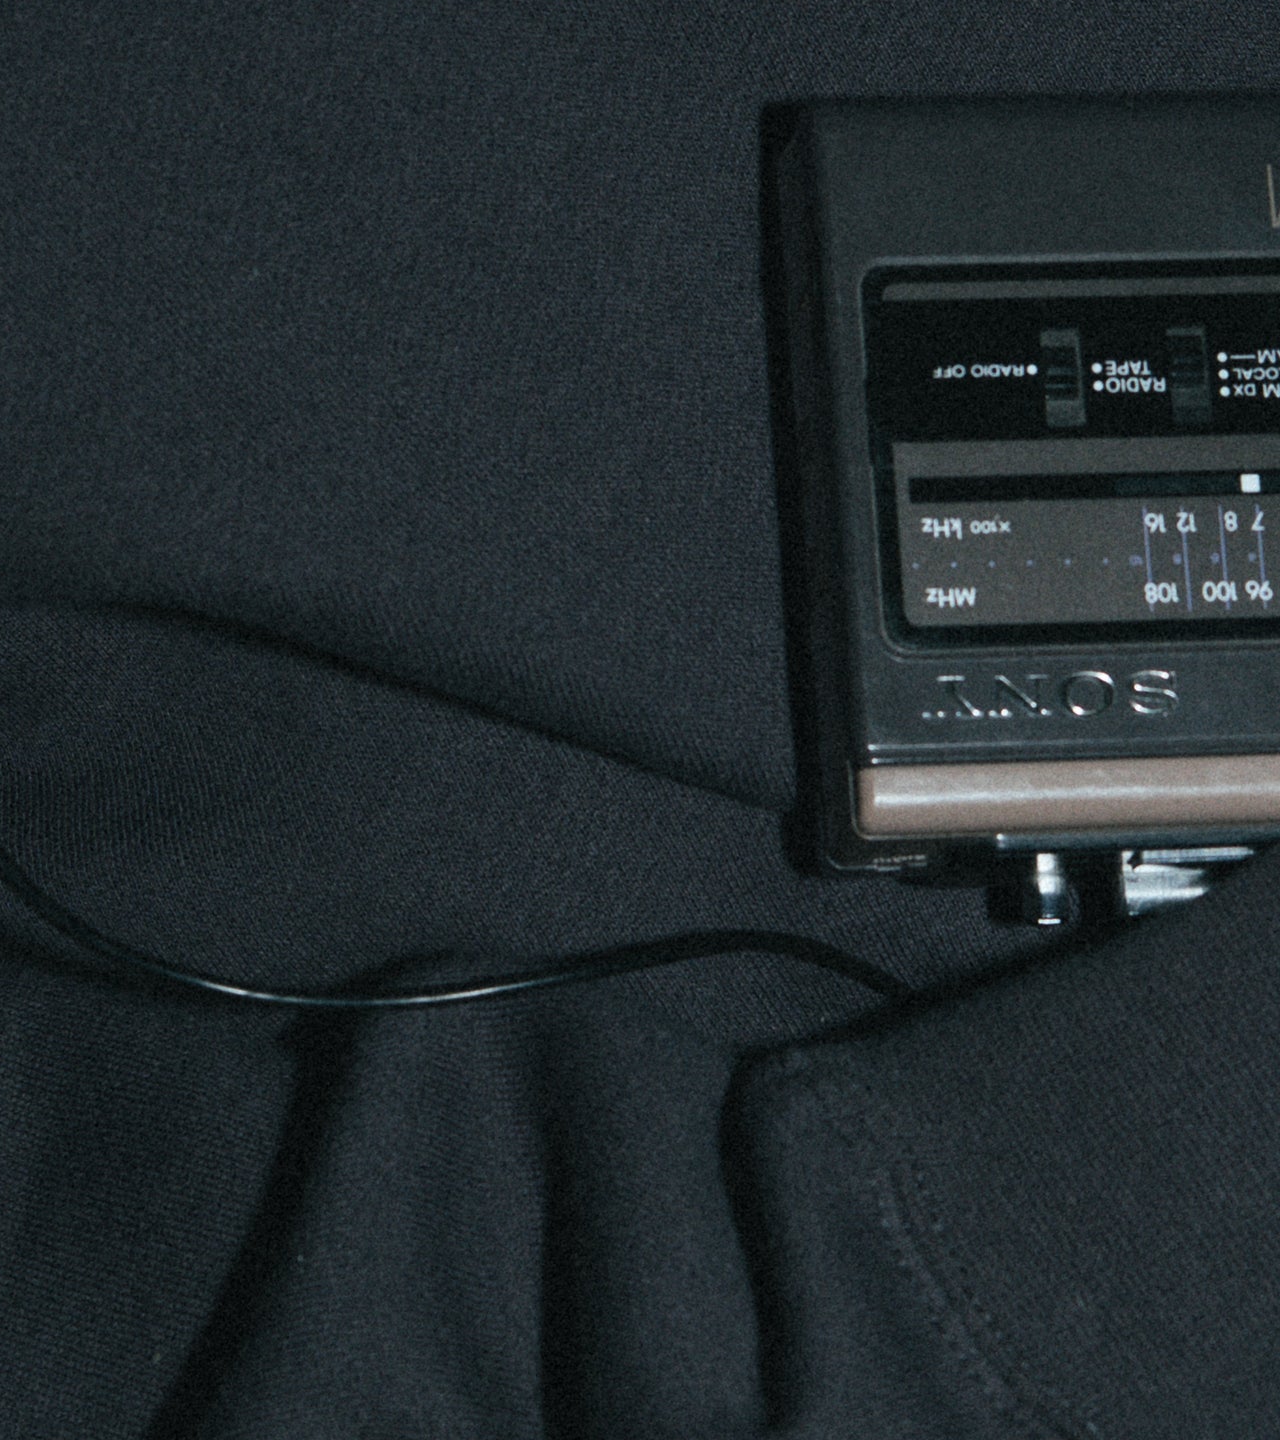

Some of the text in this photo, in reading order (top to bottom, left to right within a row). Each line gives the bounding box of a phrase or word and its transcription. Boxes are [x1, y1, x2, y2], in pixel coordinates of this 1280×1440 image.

[932, 363, 1025, 378] RADIO OFF
[1105, 360, 1151, 375] TAPE
[1105, 377, 1166, 392] RADIO
[1233, 384, 1256, 396] DX
[921, 517, 963, 540] kHz
[1144, 513, 1166, 533] 16
[1176, 512, 1197, 533] 12
[1224, 511, 1238, 532] 8
[1251, 511, 1264, 531] 7
[925, 587, 976, 608] MHz
[1144, 582, 1179, 604] 108
[1202, 580, 1238, 602] 100
[1245, 580, 1273, 601] 96
[921, 669, 1180, 719] SONY
